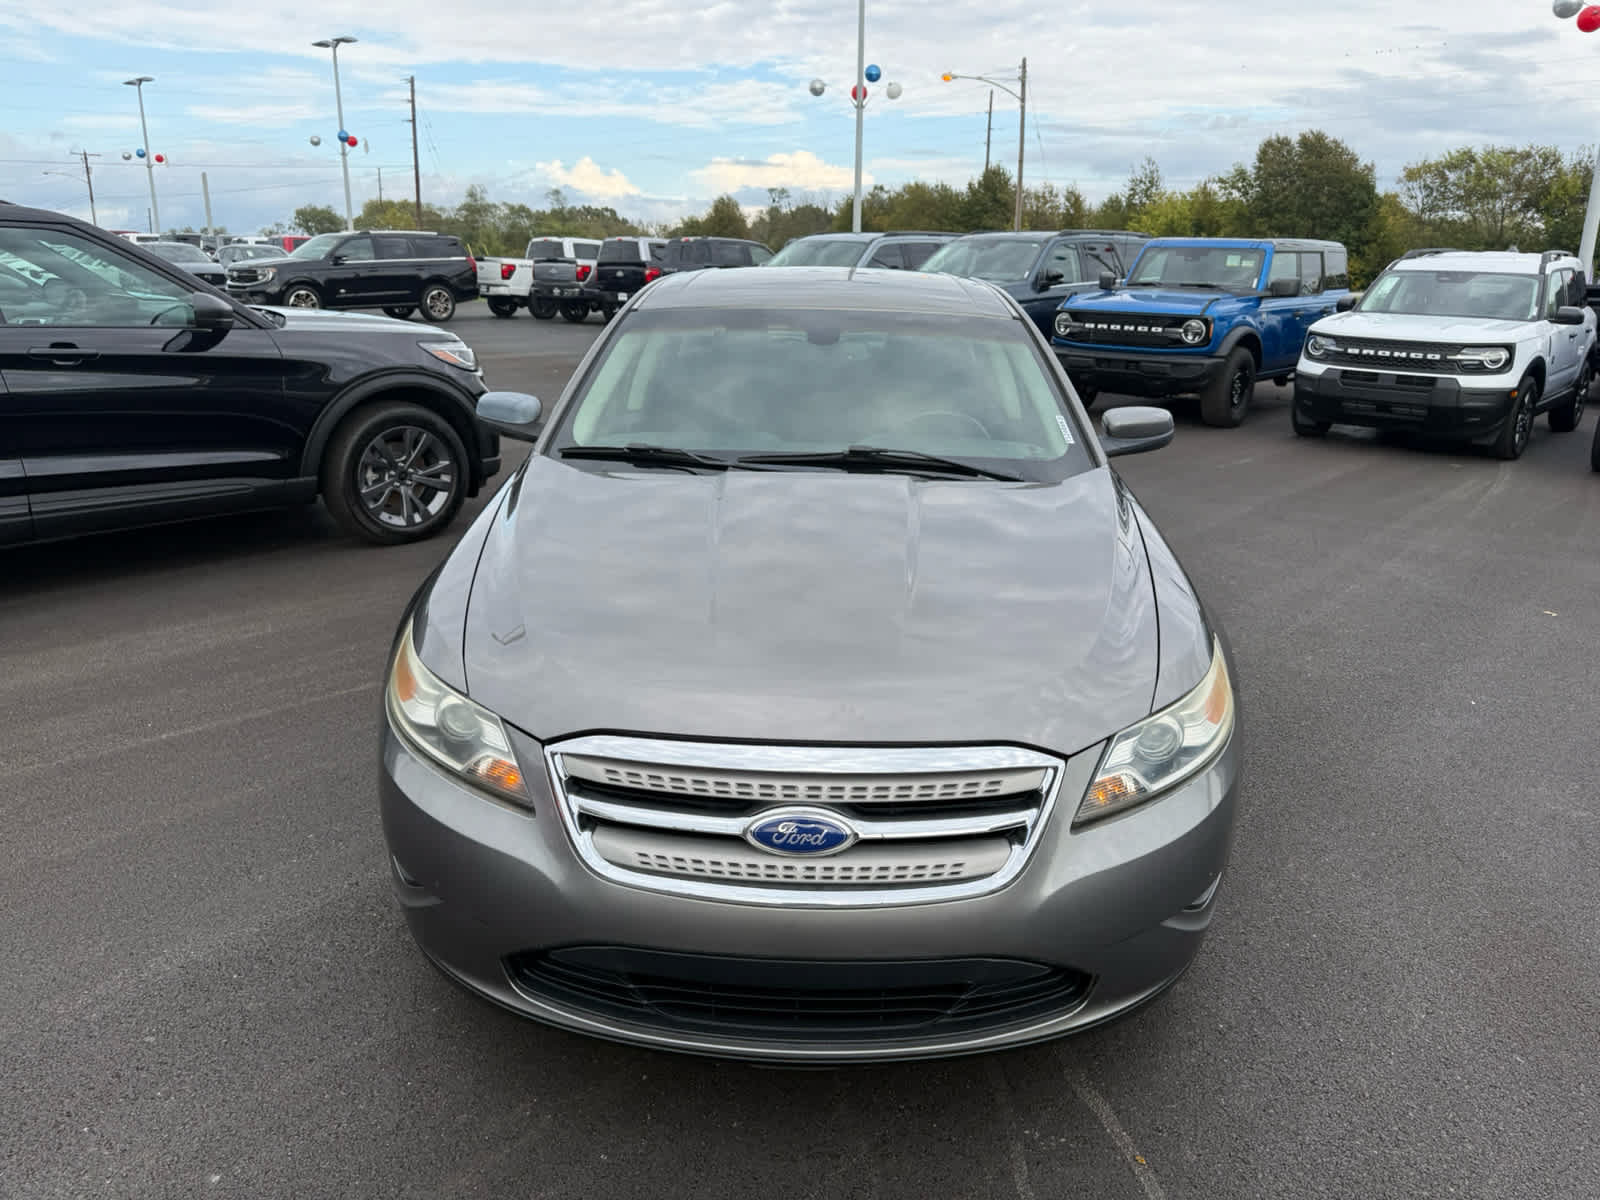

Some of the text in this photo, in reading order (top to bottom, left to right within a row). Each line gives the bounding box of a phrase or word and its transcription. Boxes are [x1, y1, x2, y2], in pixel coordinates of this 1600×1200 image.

[1084, 323, 1163, 333] BRONCO
[1347, 348, 1441, 360] BRONCO
[772, 822, 828, 845] Ford
